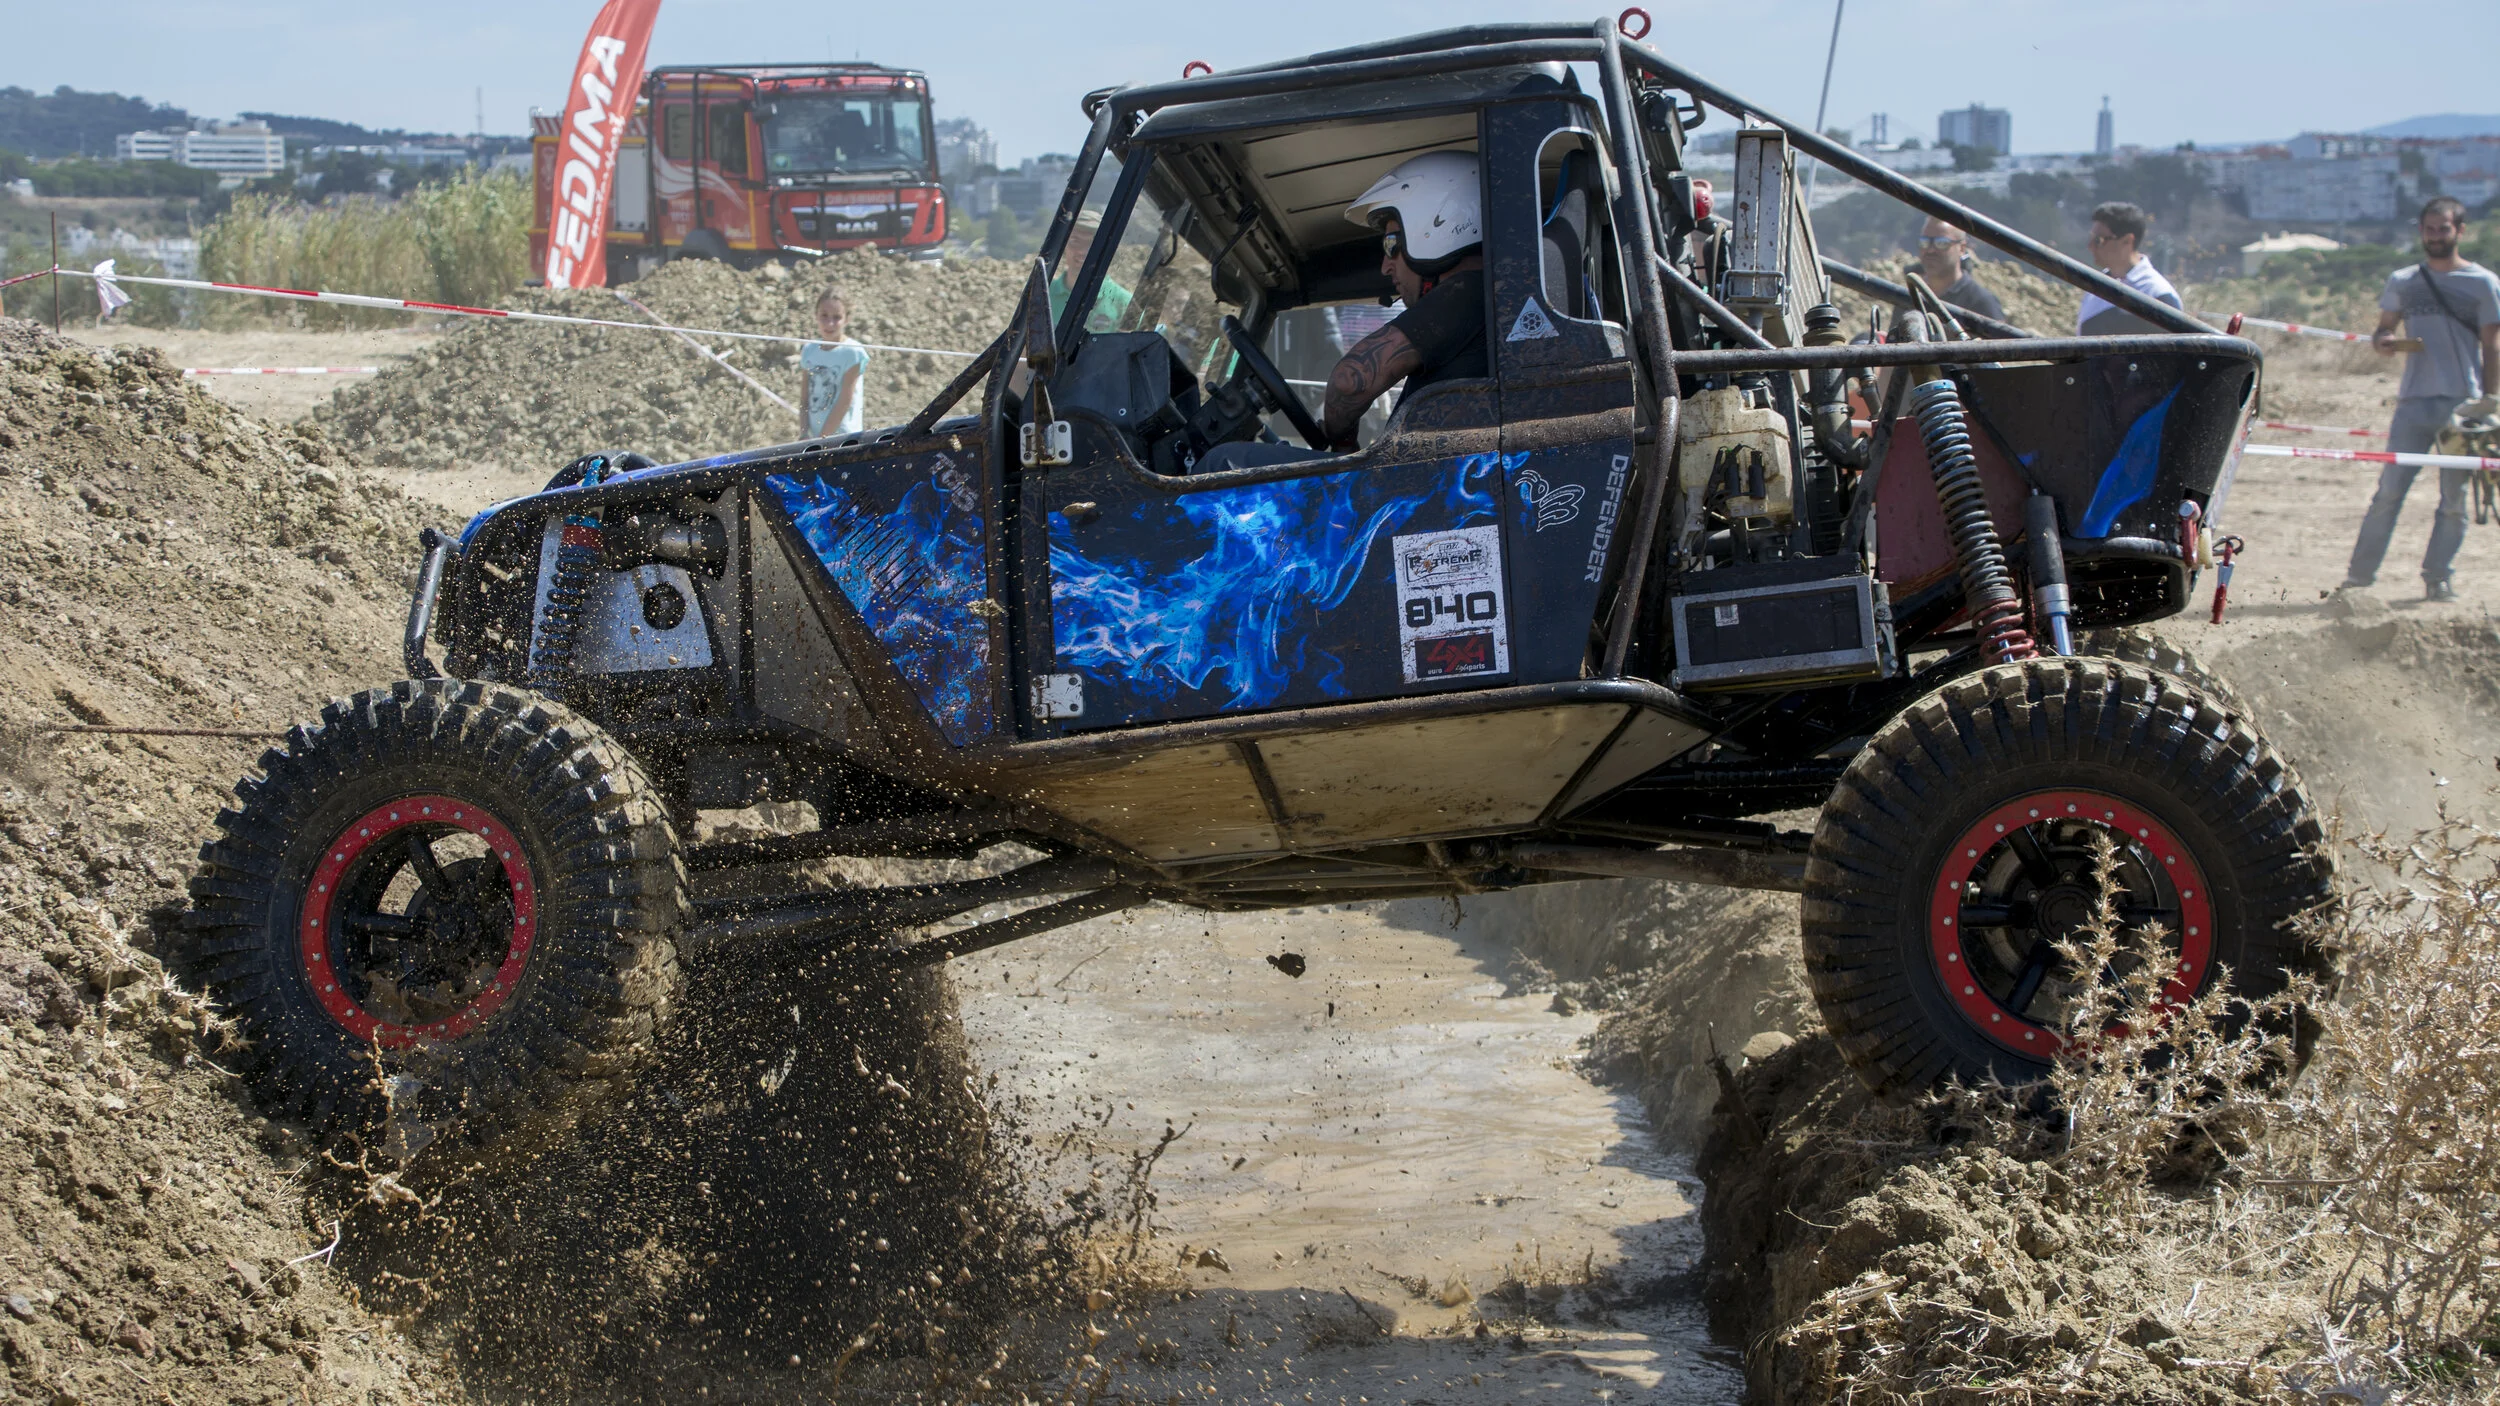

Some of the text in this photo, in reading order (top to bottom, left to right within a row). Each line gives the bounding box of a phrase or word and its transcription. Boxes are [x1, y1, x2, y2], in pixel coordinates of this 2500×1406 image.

[546, 35, 626, 290] FEDIMA
[836, 220, 878, 233] MAN
[1584, 454, 1629, 583] DEFENDER
[1405, 590, 1498, 628] 840
